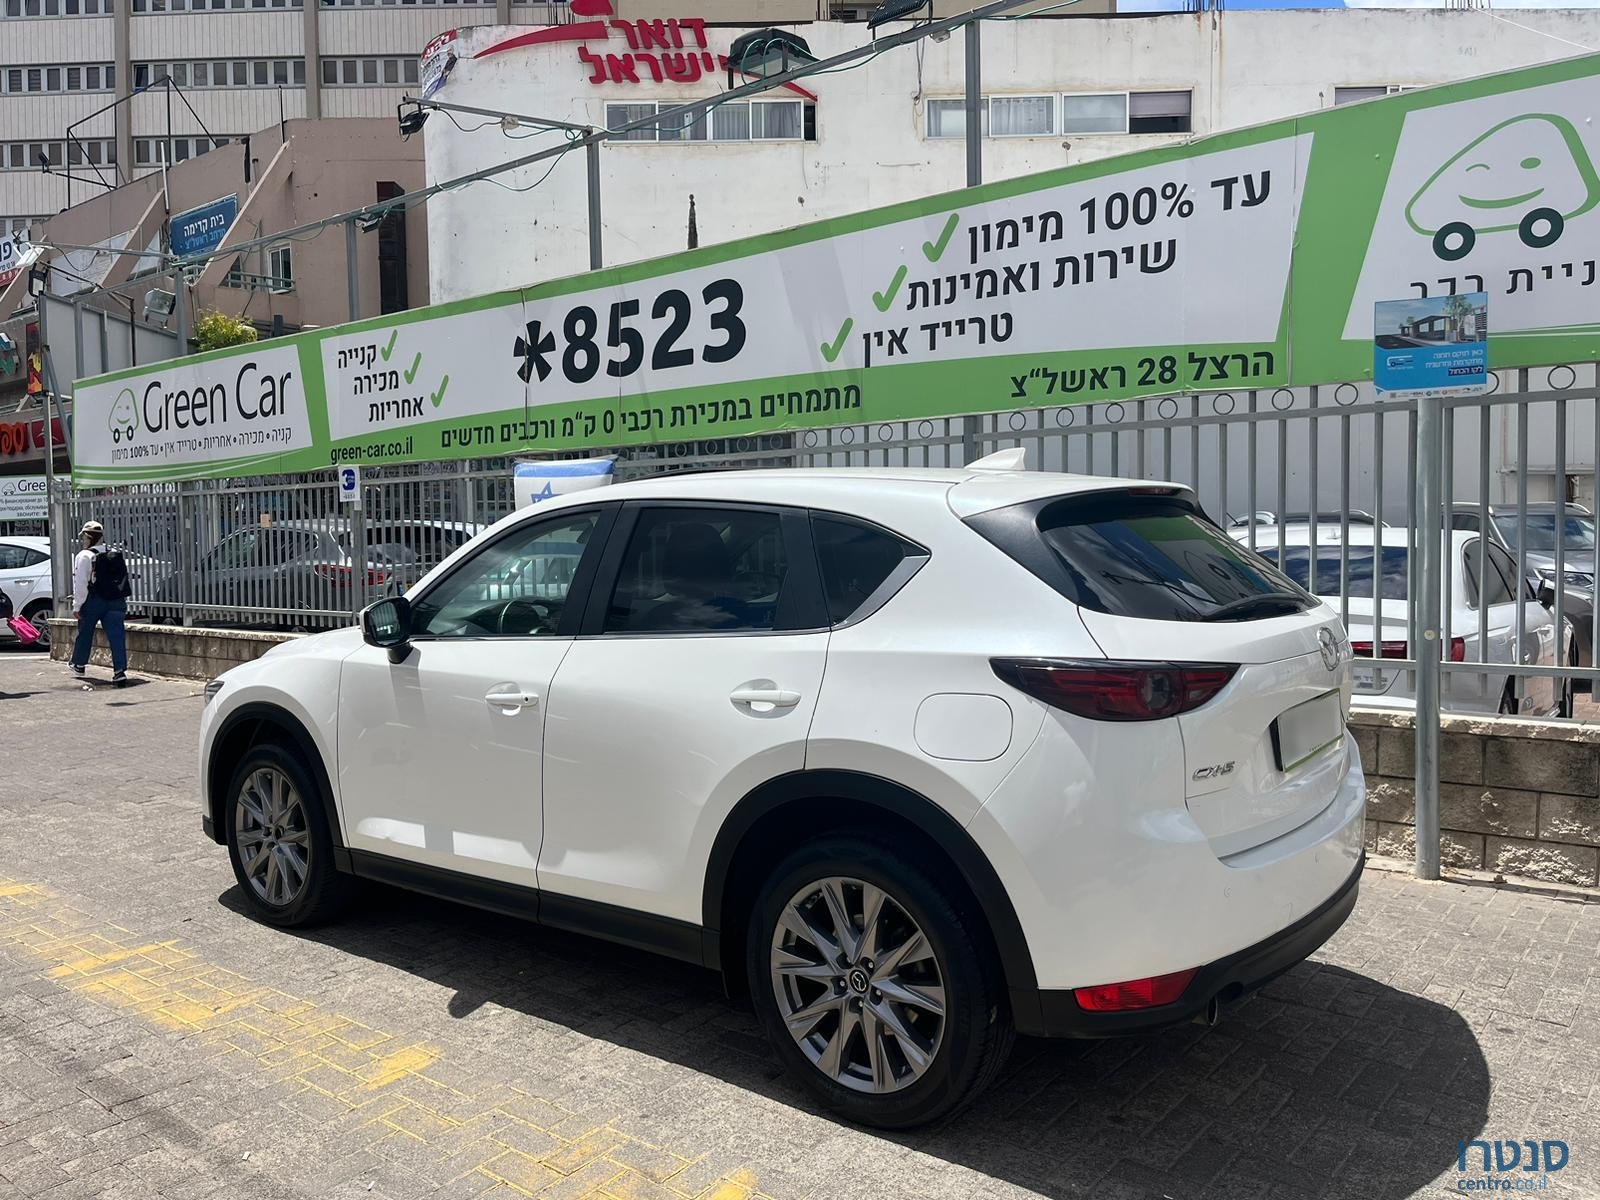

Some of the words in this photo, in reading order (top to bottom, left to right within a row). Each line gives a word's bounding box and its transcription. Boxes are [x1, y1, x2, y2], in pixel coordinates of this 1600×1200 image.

[609, 18, 707, 49] דואר
[578, 46, 715, 83] ישראל
[1210, 170, 1271, 212] עד
[210, 214, 225, 228] בית
[1080, 182, 1195, 235] 100%
[184, 219, 208, 237] קדימה
[968, 210, 1064, 265] מימון
[1053, 238, 1177, 288] שירות
[906, 260, 1040, 311] ואמינות
[1506, 260, 1596, 294] ניית
[920, 312, 1014, 351] טרייד
[338, 344, 377, 370] קנייה
[862, 326, 909, 368] אין
[1137, 355, 1177, 387] 28
[1188, 351, 1274, 381] הרצל
[353, 370, 399, 395] מכירה
[143, 381, 227, 433] Green
[236, 362, 292, 420] Car
[369, 396, 424, 423] אחריות
[760, 384, 861, 417] מתמחים
[603, 409, 615, 434] 0
[621, 409, 664, 432] רכבי
[670, 398, 752, 428] במכירת
[203, 434, 232, 450] אחריות
[239, 430, 264, 446] מכירה
[272, 427, 292, 445] קניה
[441, 426, 494, 448] חדשים
[500, 420, 555, 442] ורכבים
[111, 448, 128, 464] מימון
[130, 447, 149, 459] 100%
[150, 444, 159, 456] עד
[164, 441, 175, 458] אין
[176, 438, 197, 451] טרייד
[330, 436, 413, 465] green-car.co.il
[18, 479, 46, 491] Gree
[1192, 761, 1236, 781] CX-5
